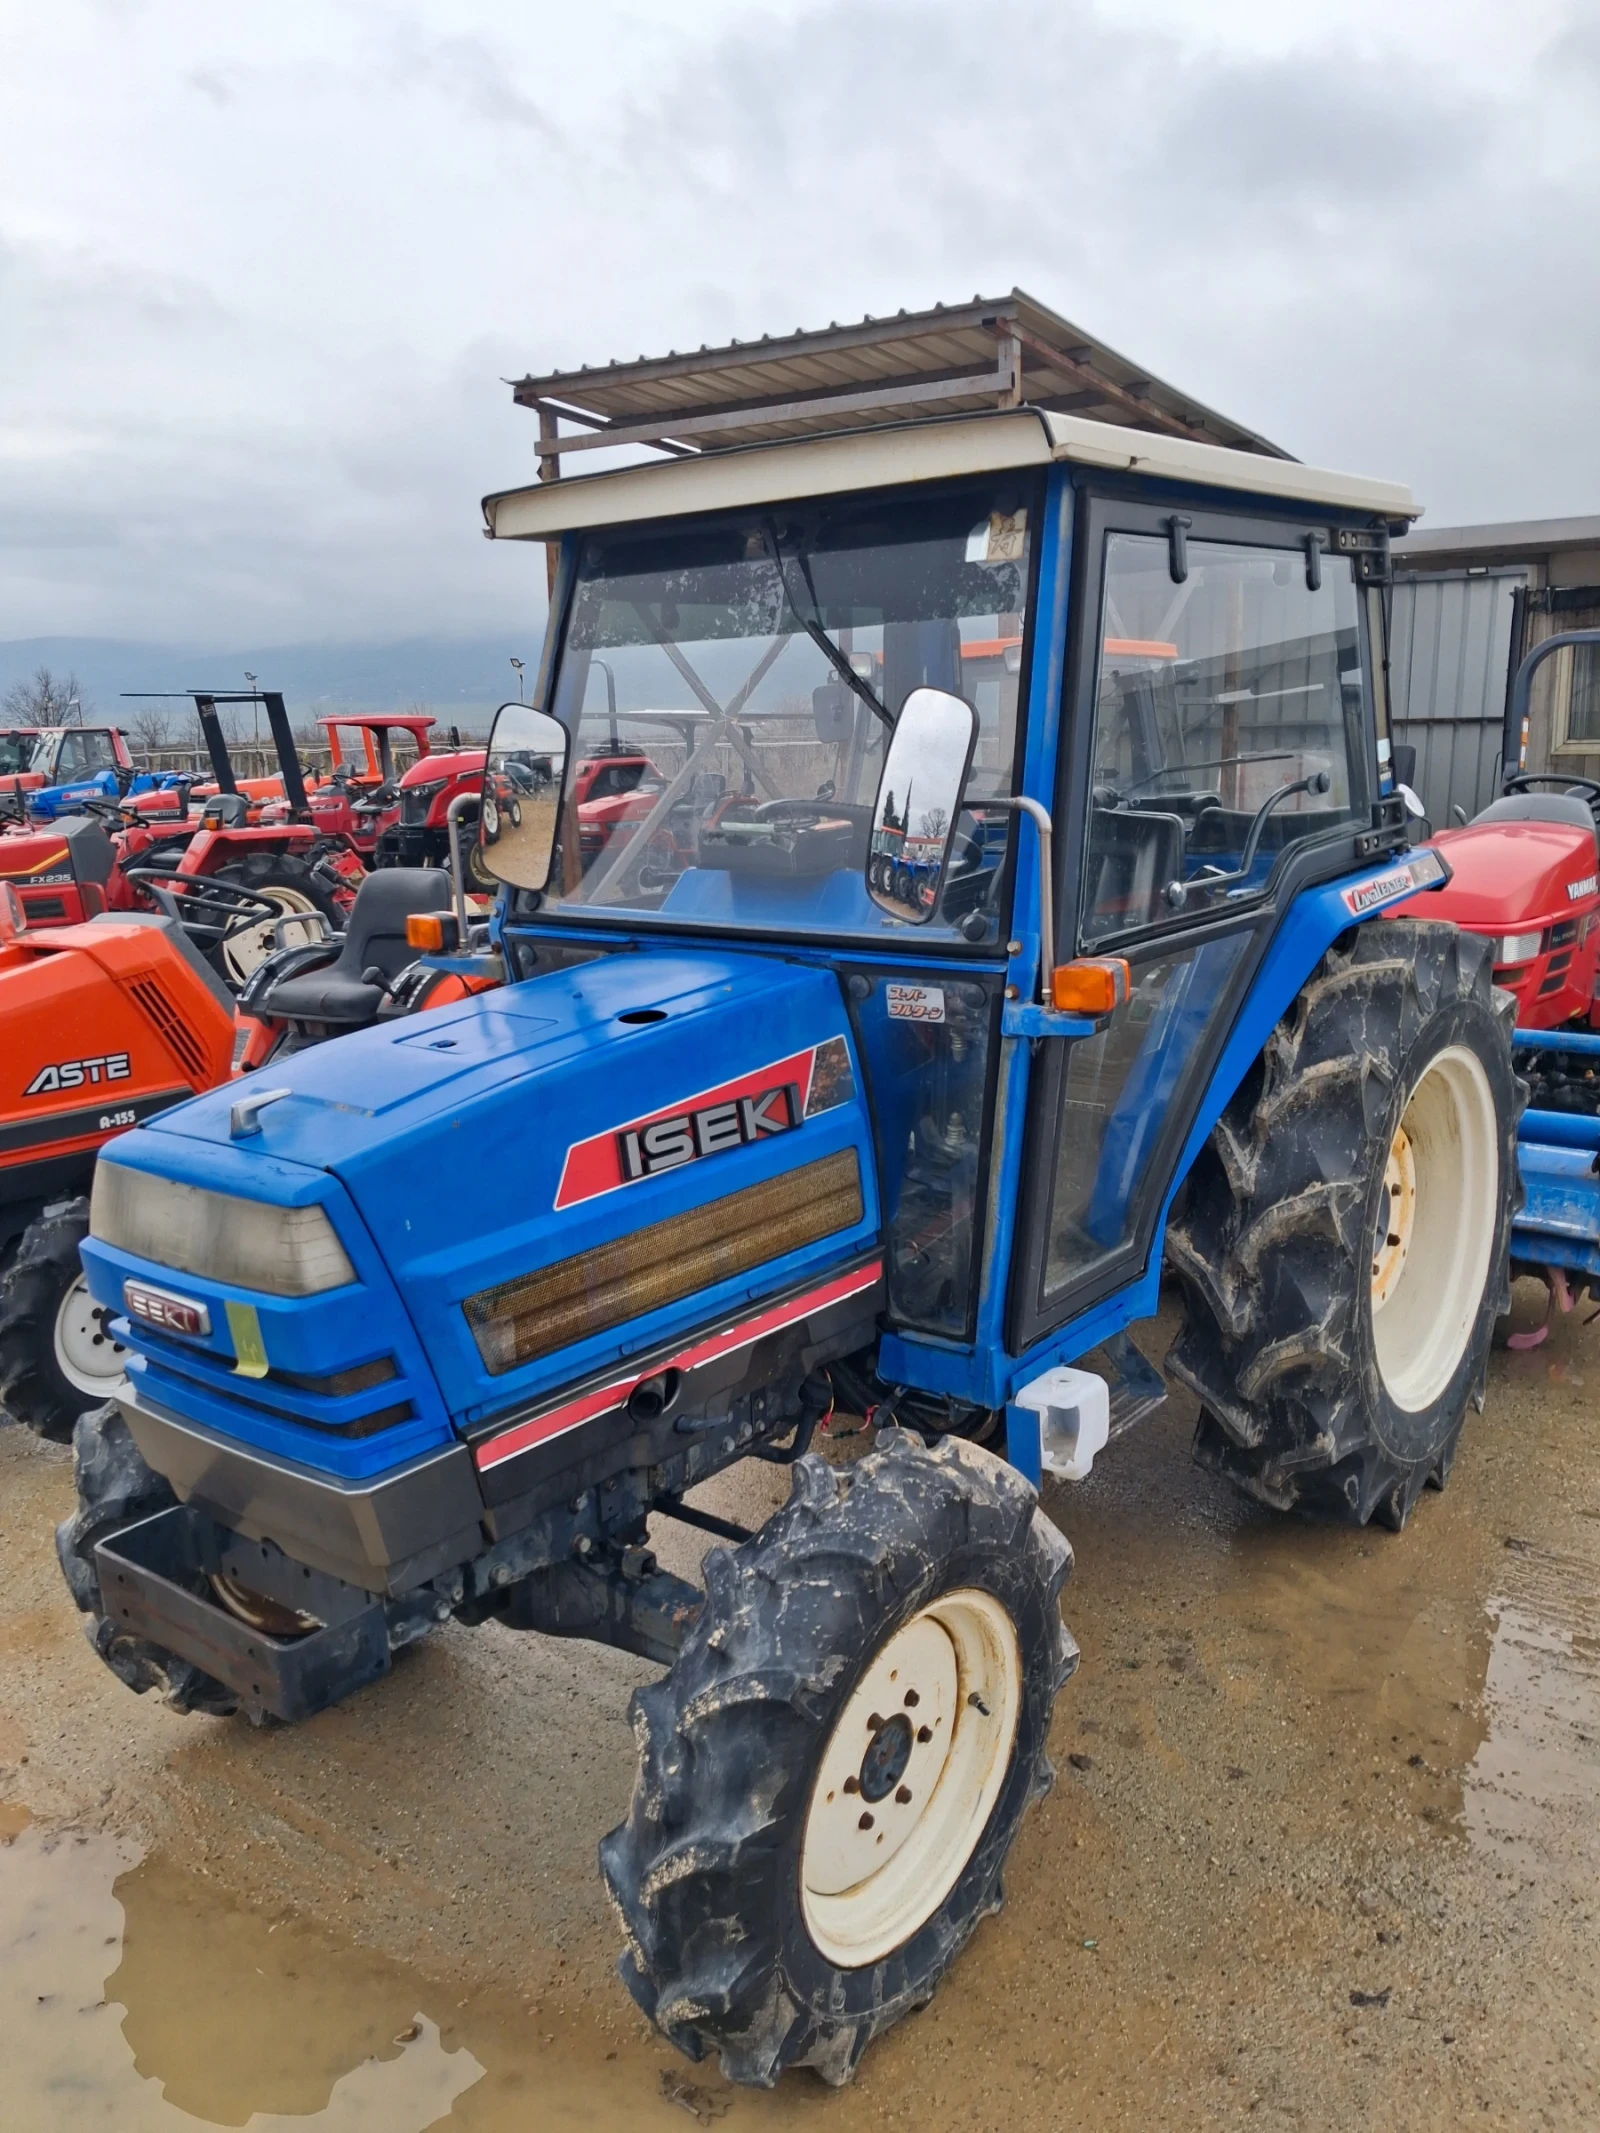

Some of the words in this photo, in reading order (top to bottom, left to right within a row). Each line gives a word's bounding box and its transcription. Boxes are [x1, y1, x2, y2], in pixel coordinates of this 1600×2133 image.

[30, 873, 71, 884] FX235
[890, 1003, 943, 1019] フルターン
[23, 1052, 131, 1095] ASTE
[100, 1110, 136, 1129] A-155
[617, 1083, 803, 1181] ISEKI
